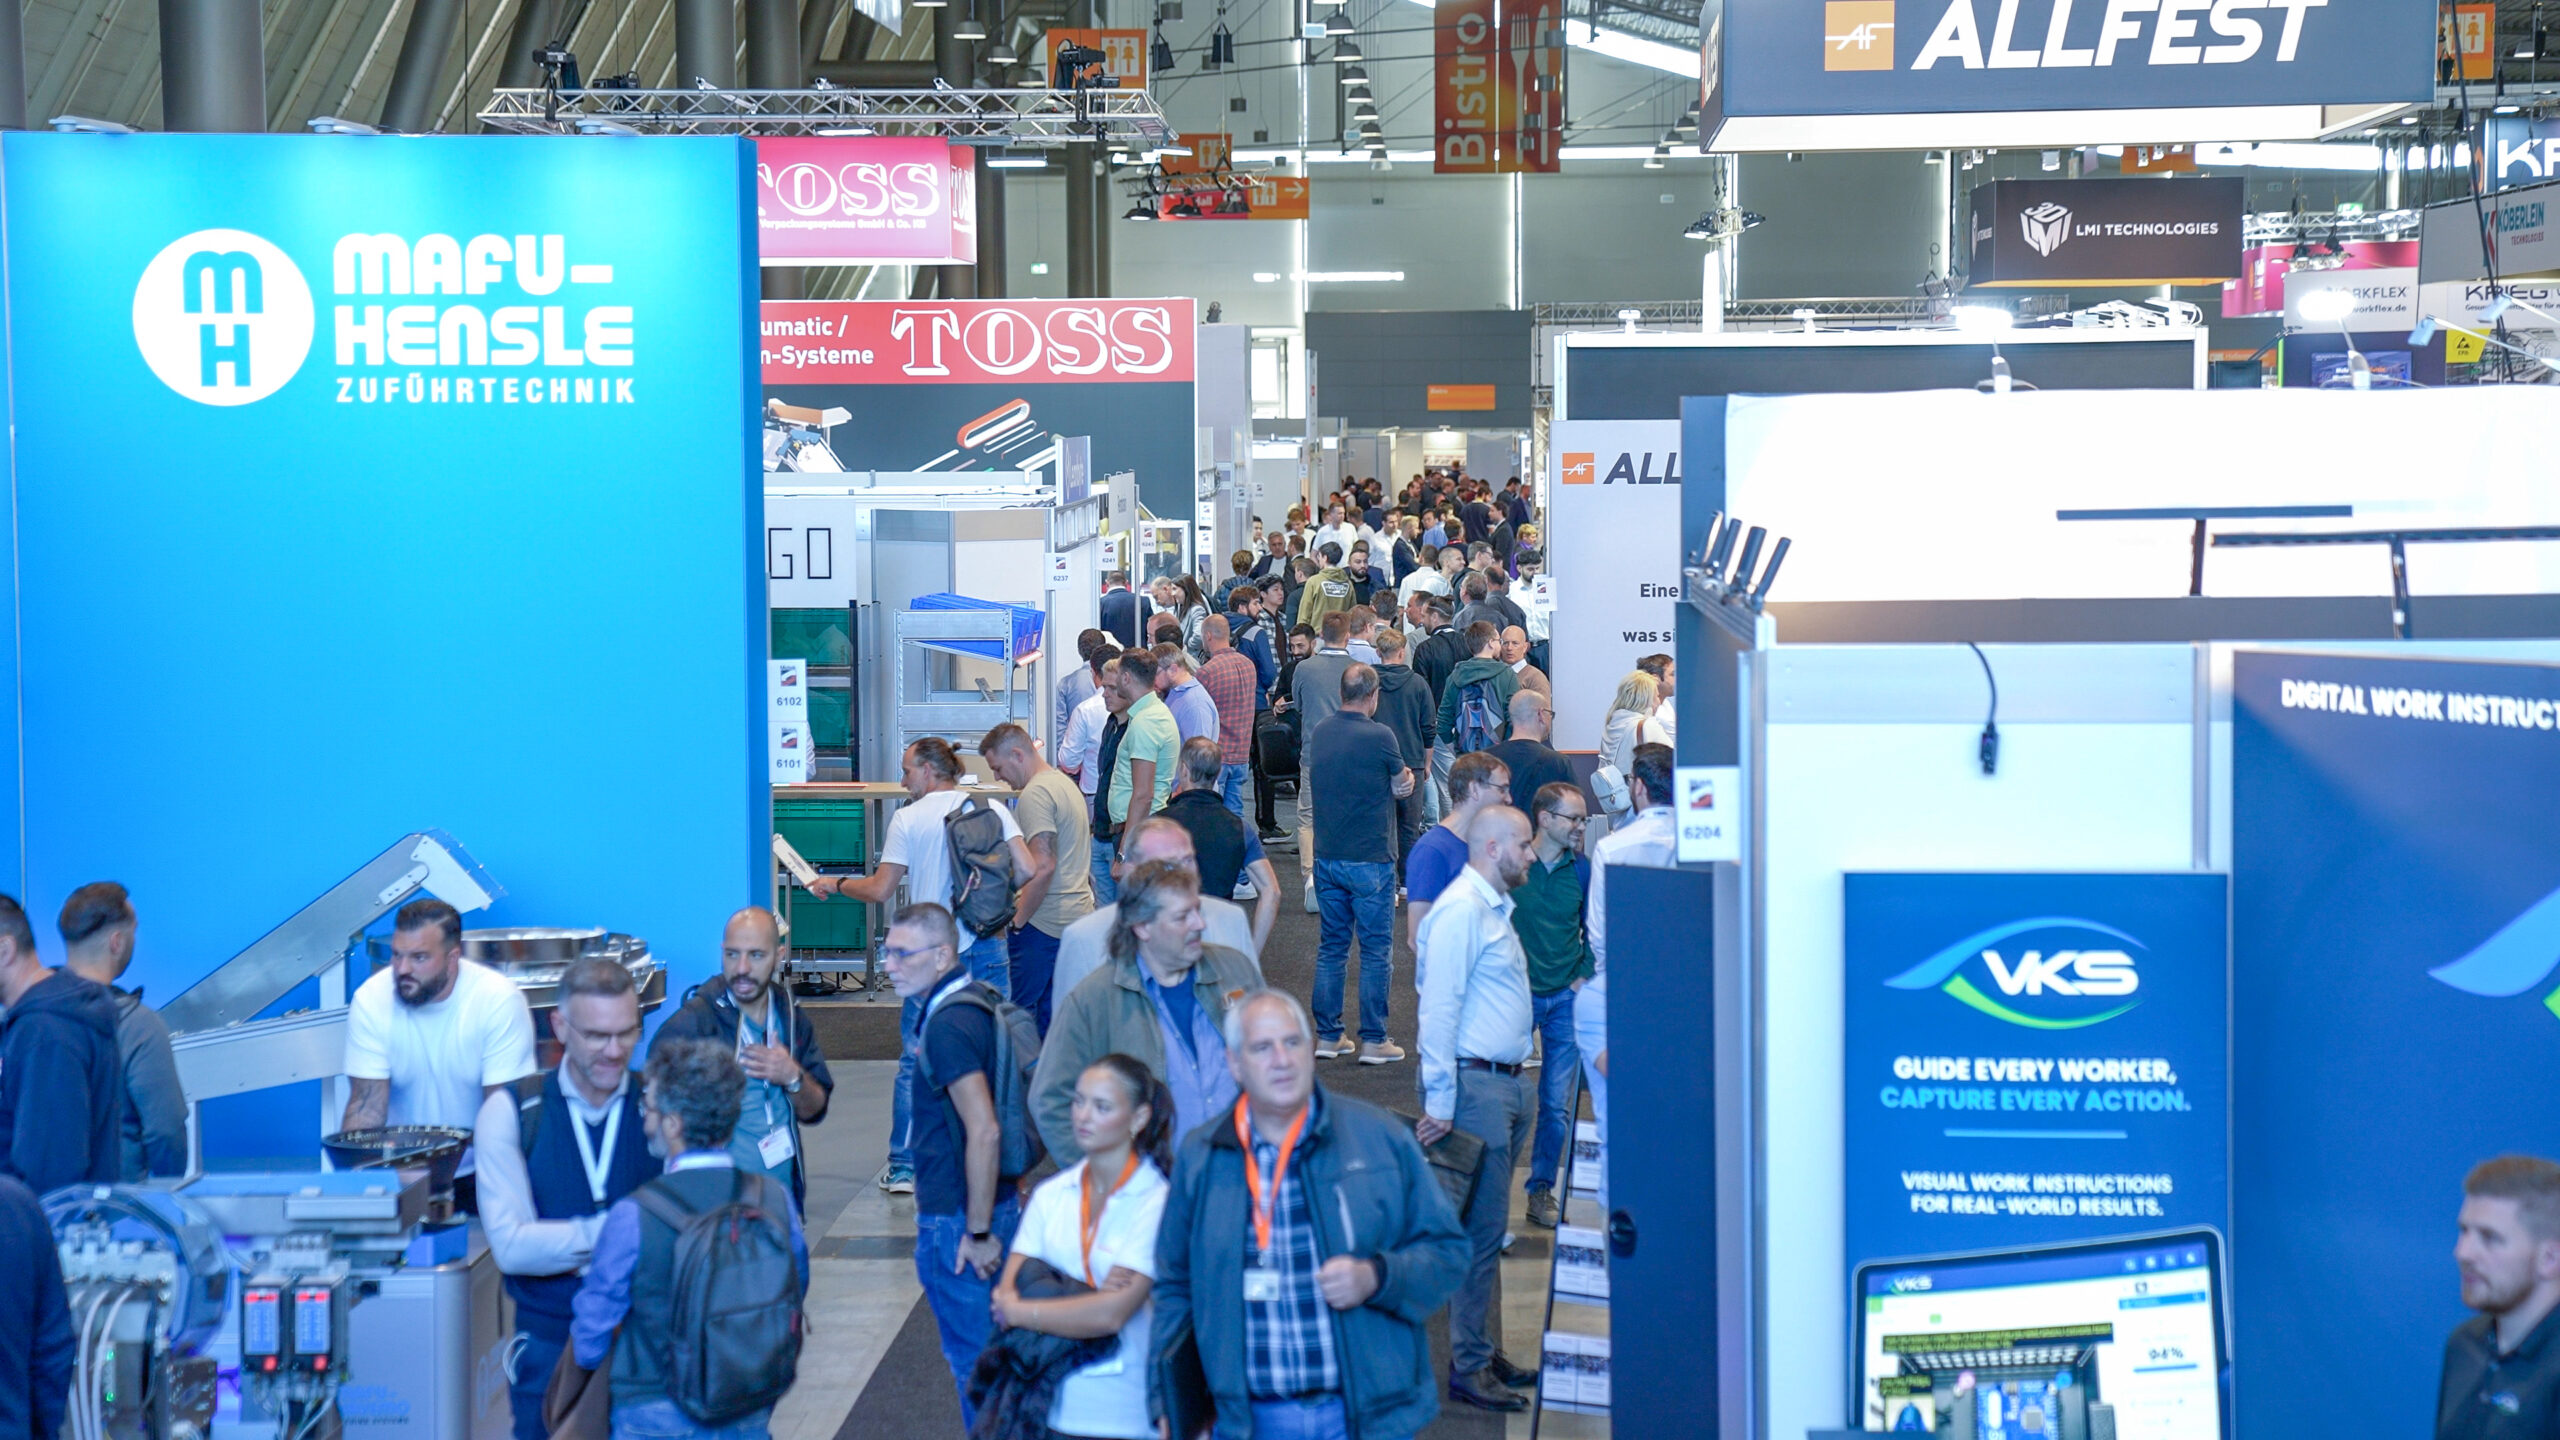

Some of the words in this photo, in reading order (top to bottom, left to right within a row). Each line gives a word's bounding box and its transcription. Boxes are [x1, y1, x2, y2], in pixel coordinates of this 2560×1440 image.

[1911, 0, 2329, 70] ALLFEST
[1444, 12, 1487, 165] Bistro
[2076, 224, 2101, 236] LMI
[2105, 222, 2219, 236] TECHNOLOGIES
[333, 233, 613, 295] MAFU-
[2338, 286, 2407, 299] RKFLEX
[334, 304, 634, 366] HENSLE
[760, 316, 833, 336] umatic
[891, 307, 1173, 375] TOSS
[760, 345, 874, 369] n-Systeme
[336, 373, 635, 403] ZUFÜHRTECHNIK
[768, 527, 832, 580] GO
[1640, 584, 1679, 597] Eine
[1623, 631, 1658, 642] was
[777, 697, 802, 706] 6102
[2281, 678, 2368, 715] DIGITAL
[2369, 687, 2444, 721] WORK
[776, 759, 801, 768] 6101
[1684, 826, 1722, 839] 6204
[1981, 949, 2139, 996] VKS
[1893, 1056, 1971, 1081] GUIDE
[1974, 1057, 2055, 1082] EVERY
[2058, 1058, 2177, 1085] WORKER,
[1880, 1086, 1997, 1110] CAPTURE
[2001, 1088, 2081, 1111] EVERY
[2084, 1089, 2193, 1112] ACTION.
[1901, 1171, 1969, 1192] VISUAL
[1970, 1172, 2031, 1193] WORK
[2032, 1174, 2174, 1195] INSTRUCTIONS
[1910, 1194, 1950, 1214] FOR
[1951, 1195, 2077, 1216] REAL-WORLD
[2078, 1197, 2165, 1217] RESULTS.
